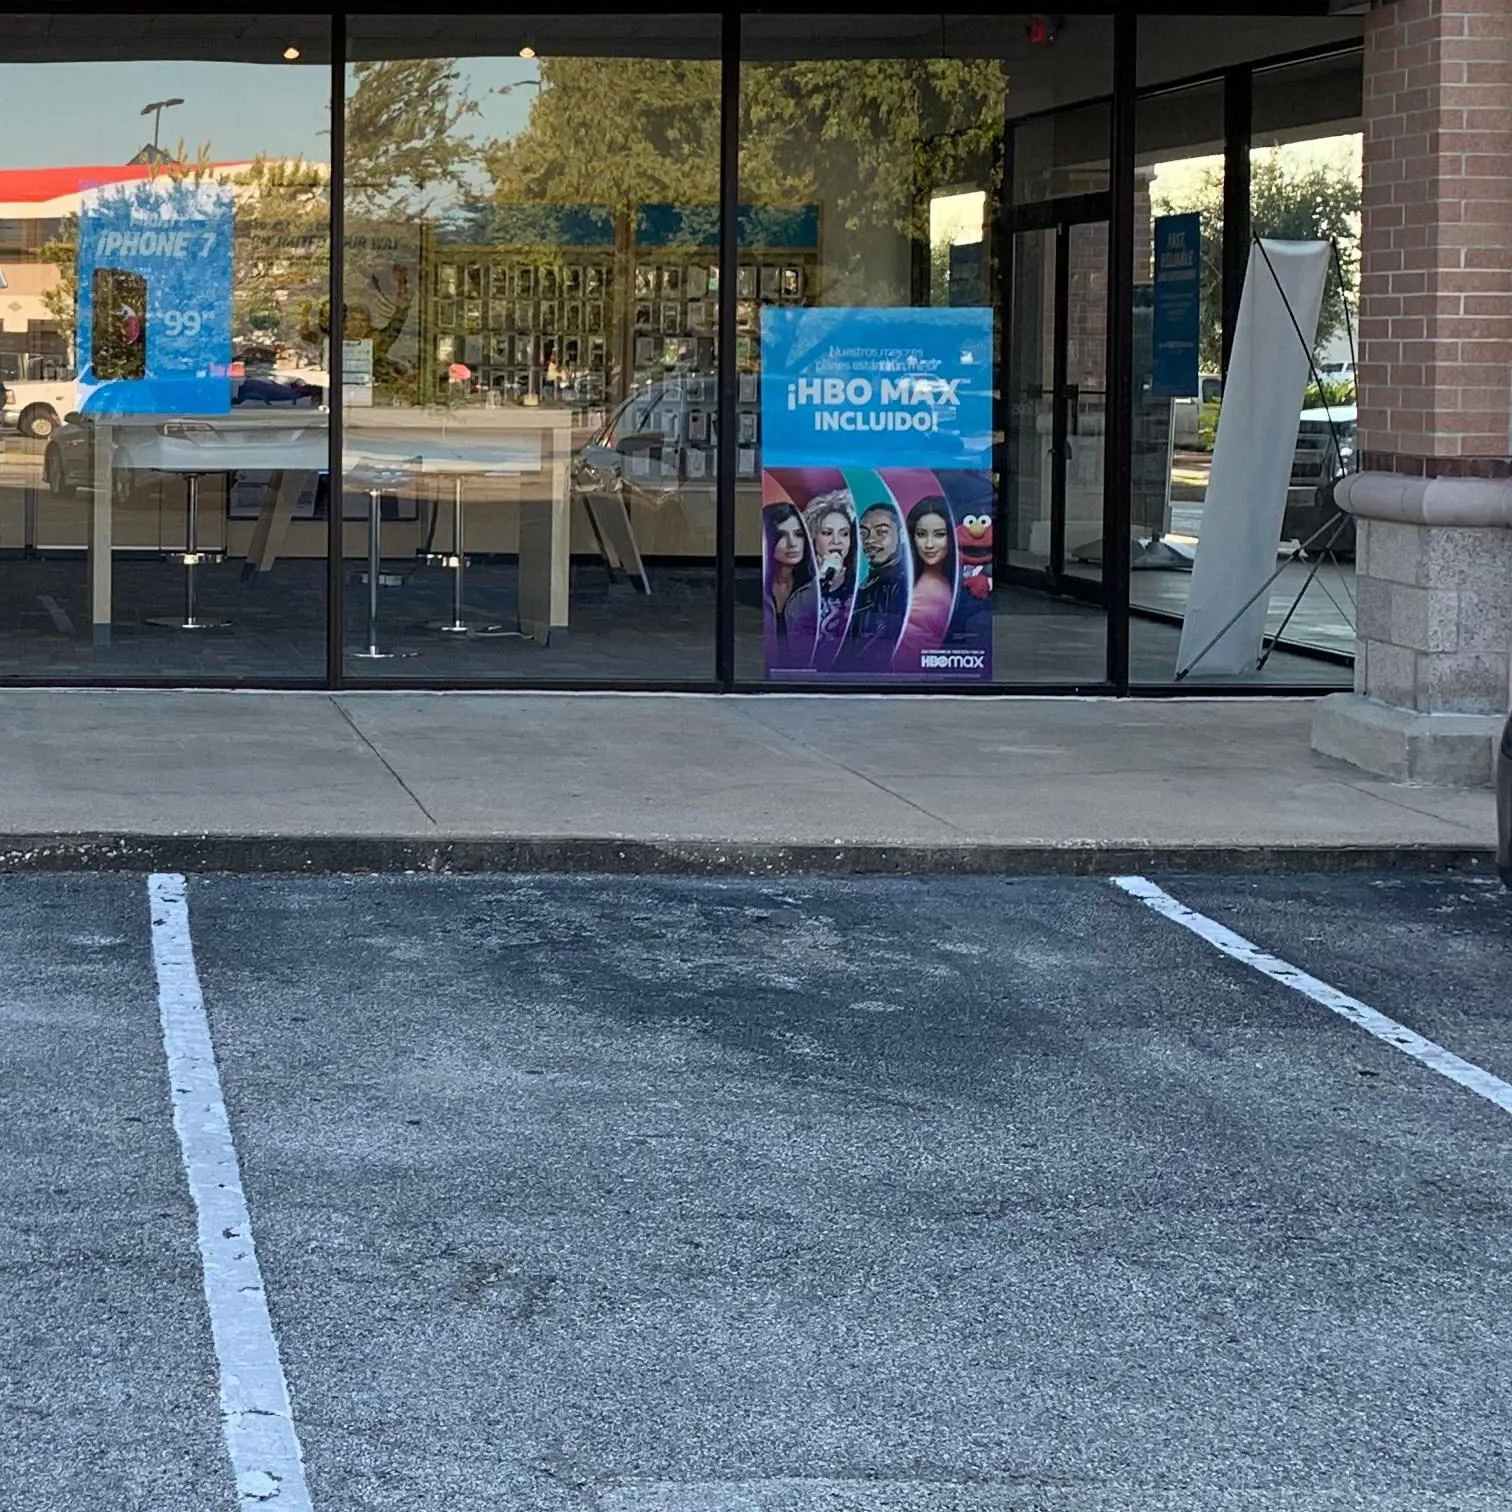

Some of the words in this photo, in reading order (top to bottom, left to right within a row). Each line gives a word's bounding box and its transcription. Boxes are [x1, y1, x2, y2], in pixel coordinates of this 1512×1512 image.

[96, 229, 188, 257] iPHONE
[197, 231, 217, 258] 7
[829, 345, 878, 358] Nuestros
[788, 378, 873, 410] ¡HBO
[881, 378, 961, 406] MAX
[815, 411, 938, 433] INCLUIDO!
